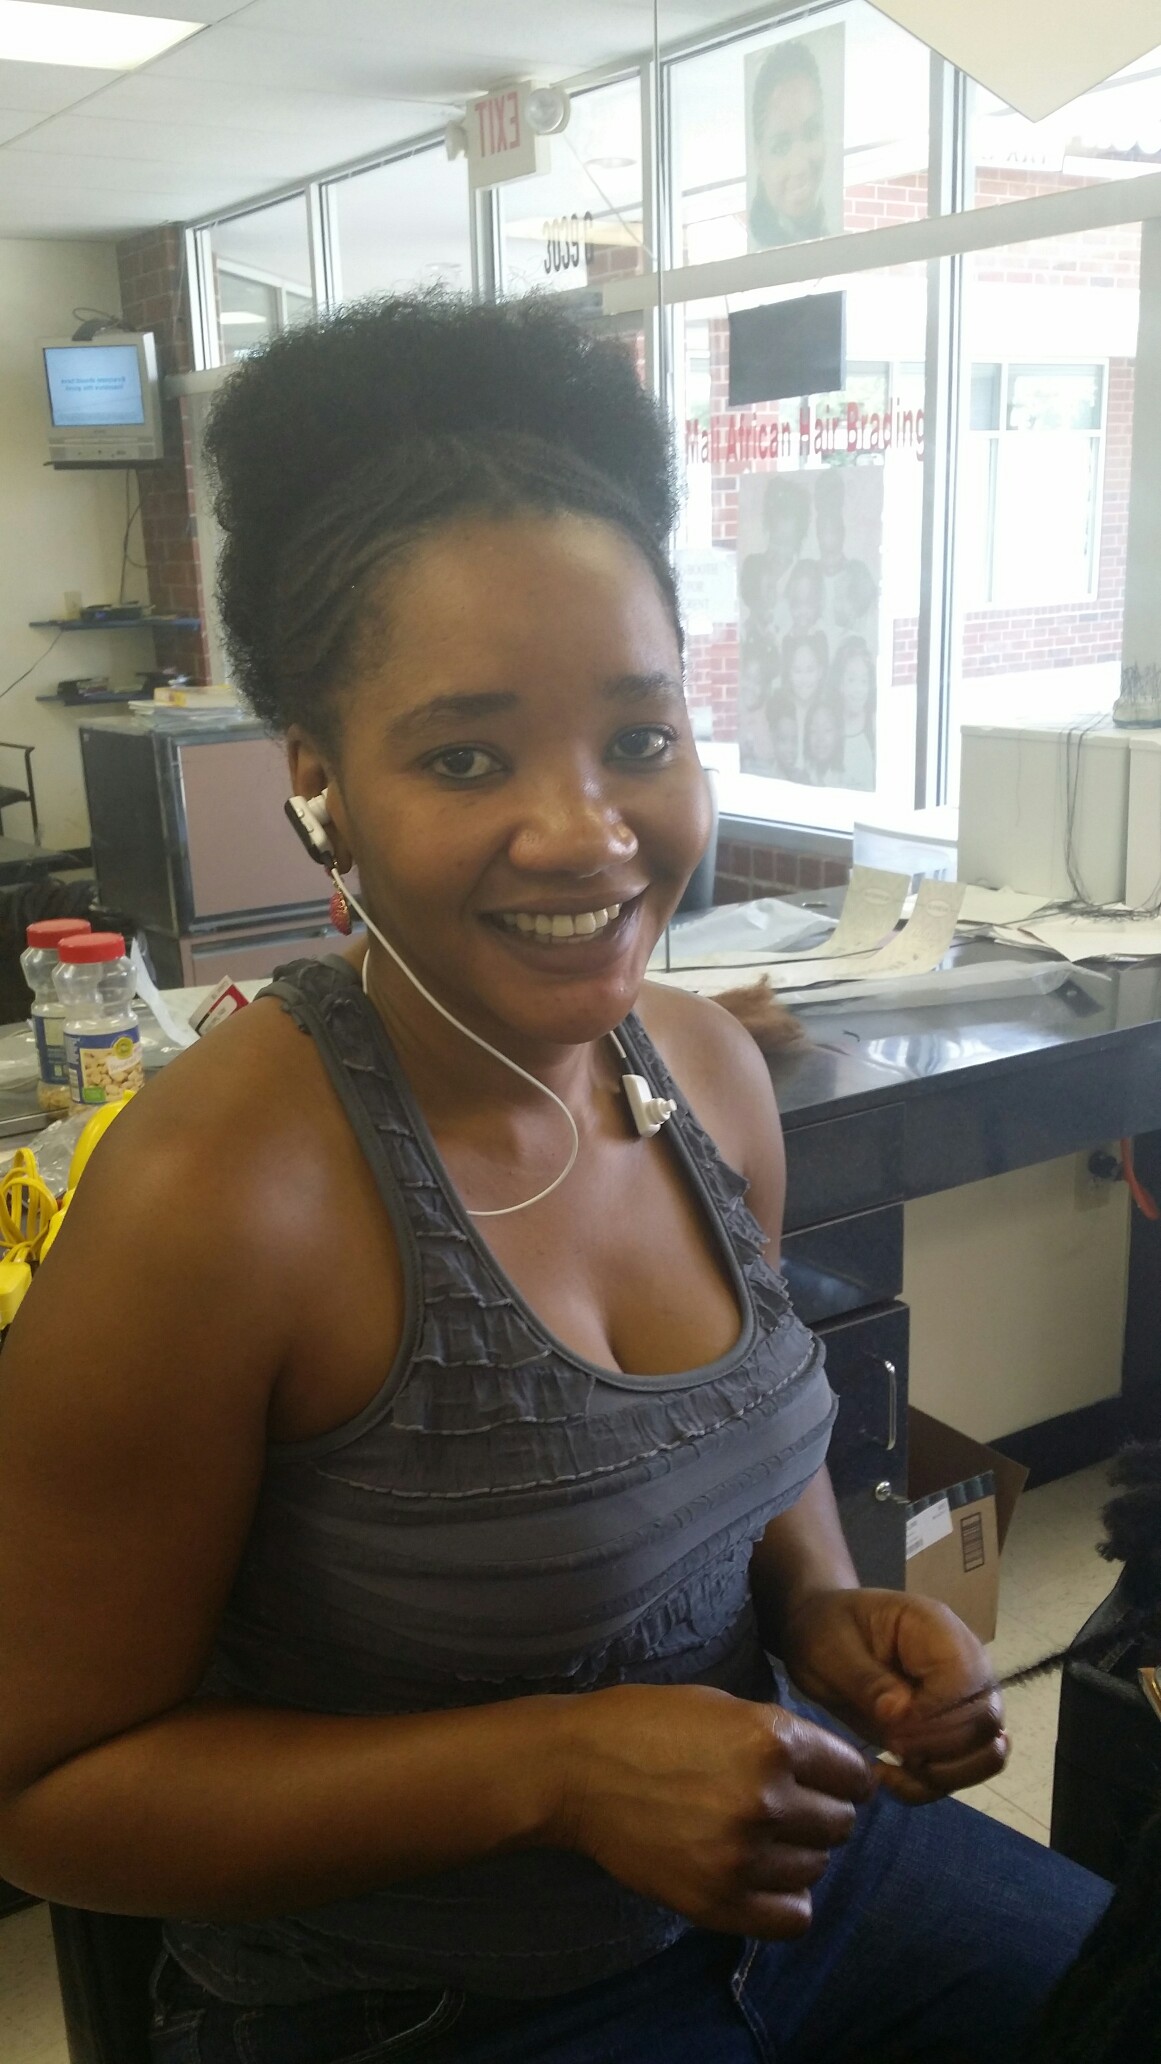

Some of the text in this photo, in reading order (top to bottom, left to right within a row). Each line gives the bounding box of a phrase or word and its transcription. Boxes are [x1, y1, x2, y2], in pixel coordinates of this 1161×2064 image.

[727, 412, 791, 462] African
[799, 403, 840, 456] Hair
[846, 397, 925, 461] Brading
